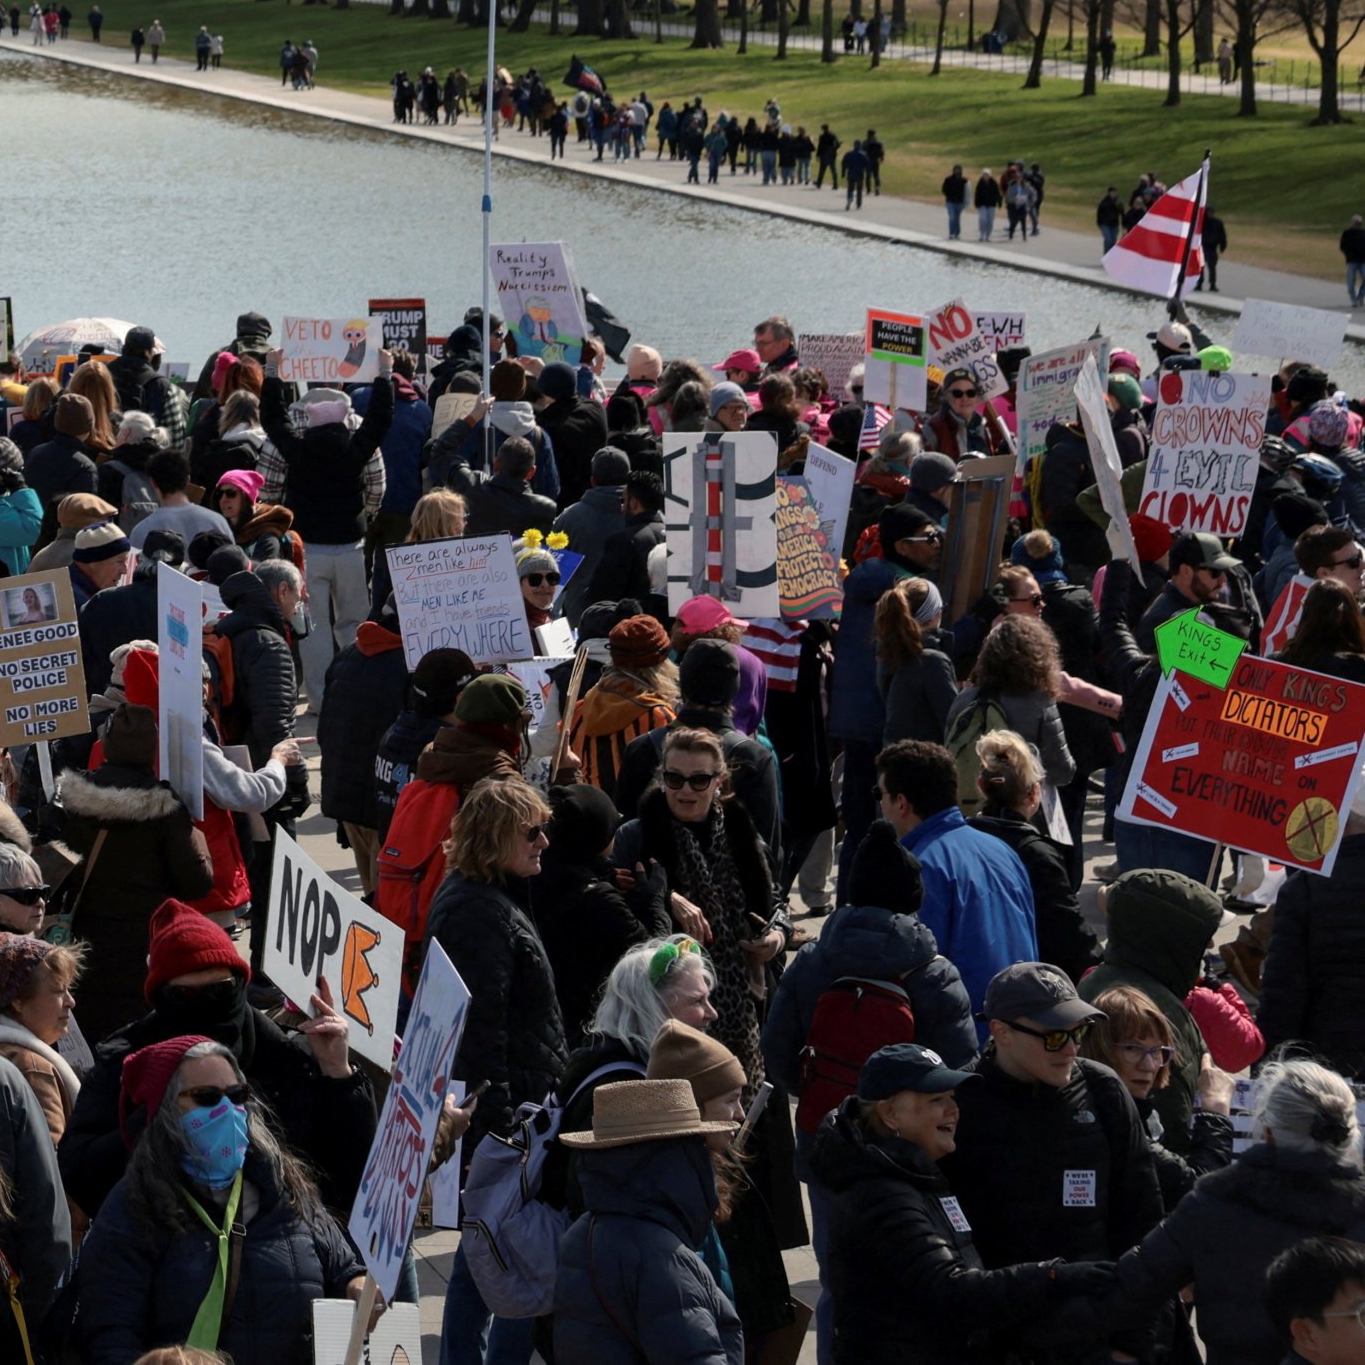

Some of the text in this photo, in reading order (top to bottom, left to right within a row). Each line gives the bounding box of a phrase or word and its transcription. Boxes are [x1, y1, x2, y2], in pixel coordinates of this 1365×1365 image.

[497, 250, 547, 268] Reality
[510, 267, 555, 280] Trumps
[498, 281, 567, 292] Narcissism
[284, 318, 332, 340] VETO
[877, 331, 917, 345] HAVE THE
[881, 321, 912, 333] PEOPLE
[929, 306, 973, 351] NO
[881, 342, 912, 354] POWER
[278, 356, 339, 380] CHEETO
[1188, 372, 1236, 404] NO
[1154, 405, 1264, 450] CROWNS
[810, 455, 838, 476] DEFEND
[1150, 448, 1253, 495] 4 EVIL
[1138, 490, 1250, 534] CLOWNS
[388, 541, 499, 569] There are always
[417, 556, 488, 576] men like him
[423, 578, 456, 593] there
[458, 576, 478, 586] are
[481, 570, 508, 583] also
[421, 595, 441, 612] MEN
[446, 591, 469, 607] LIKE
[405, 601, 511, 631] and I have friends
[34, 623, 77, 643] GOOD
[1178, 619, 1222, 651] KINGS
[21, 652, 77, 672] SECRET
[1178, 643, 1206, 664] Exit
[12, 671, 66, 692] POLICE
[1236, 663, 1348, 714] ONLY KINGS
[6, 698, 78, 723] NO MORE
[1224, 690, 1323, 744] DICTATORS
[25, 720, 57, 736] LIES
[1222, 748, 1287, 786] NAME
[1297, 774, 1319, 792] ON
[1171, 765, 1289, 827] EVERYTHING
